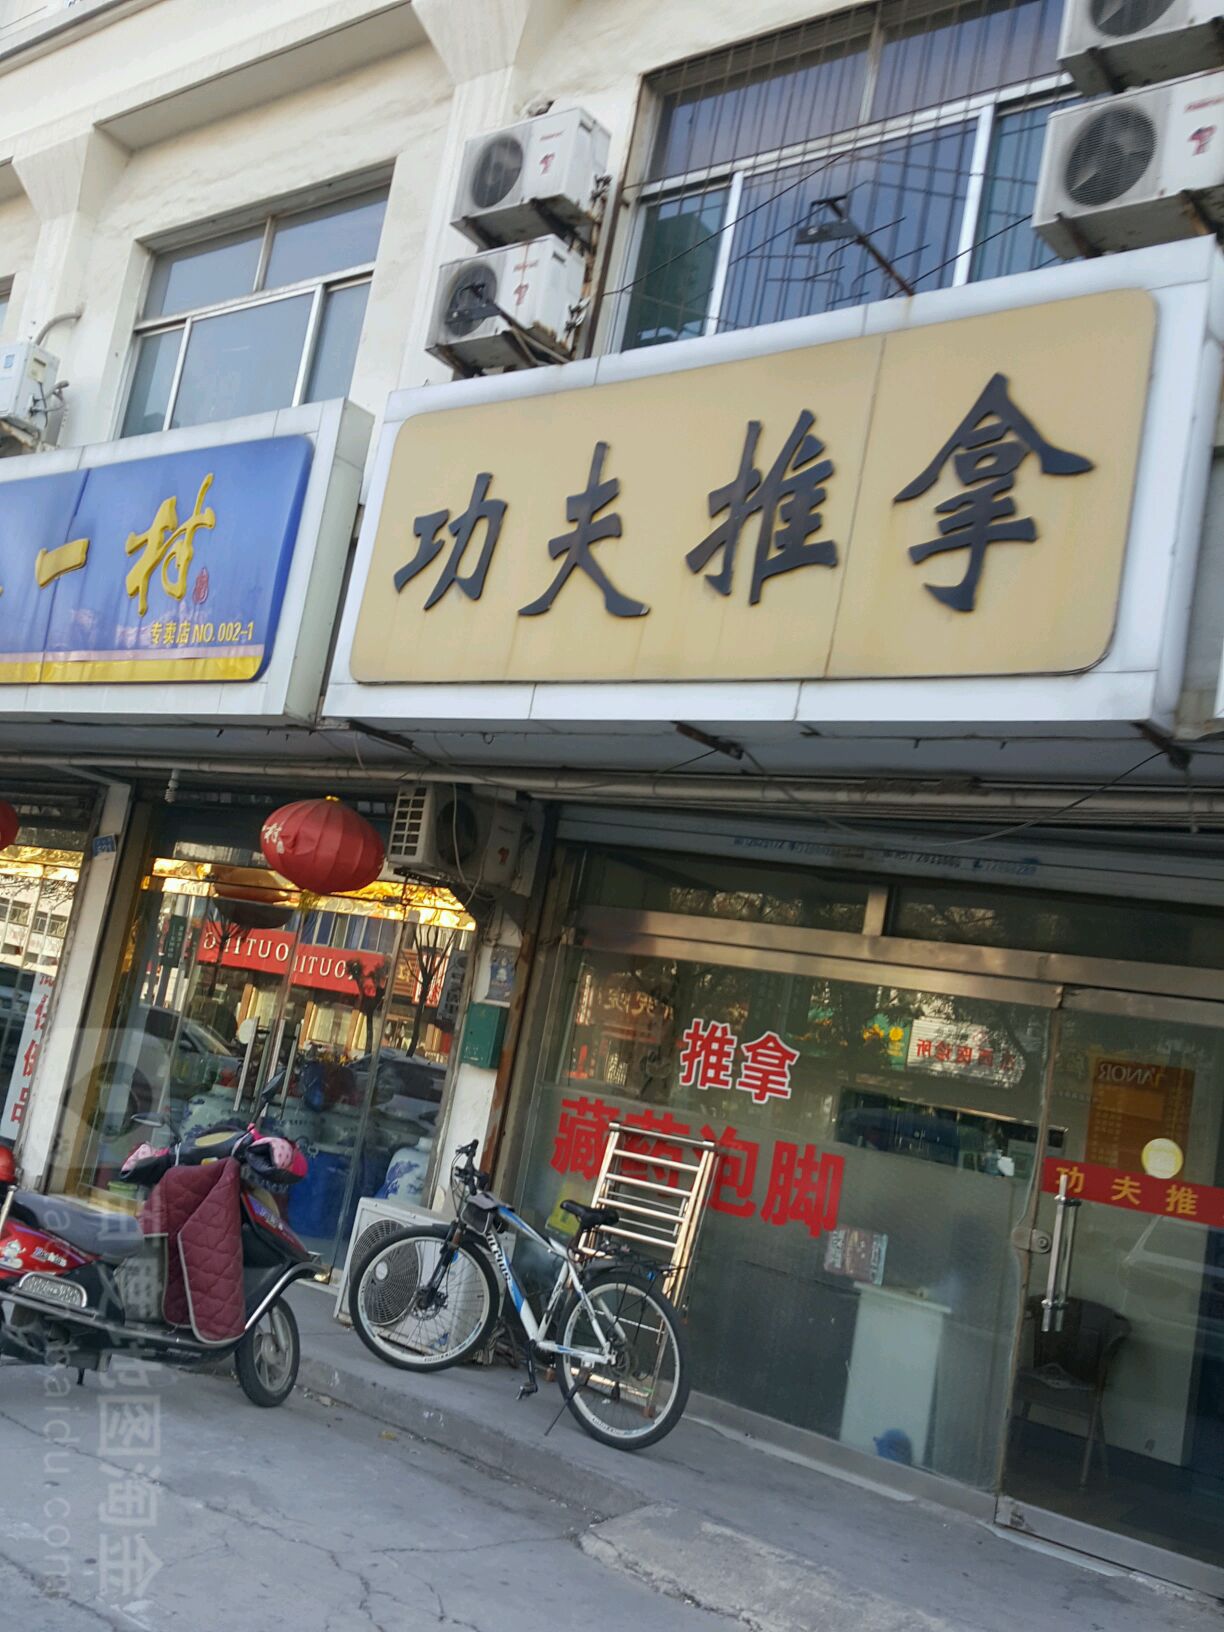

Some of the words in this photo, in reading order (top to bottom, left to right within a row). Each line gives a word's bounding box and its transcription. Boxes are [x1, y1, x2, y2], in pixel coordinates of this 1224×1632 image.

[0, 473, 216, 617] 一村
[393, 371, 1096, 618] 功夫推拿
[678, 1018, 800, 1104] 推拿
[550, 1096, 846, 1239] 藏药泡脚
[1055, 1166, 1224, 1222] 功夫推
